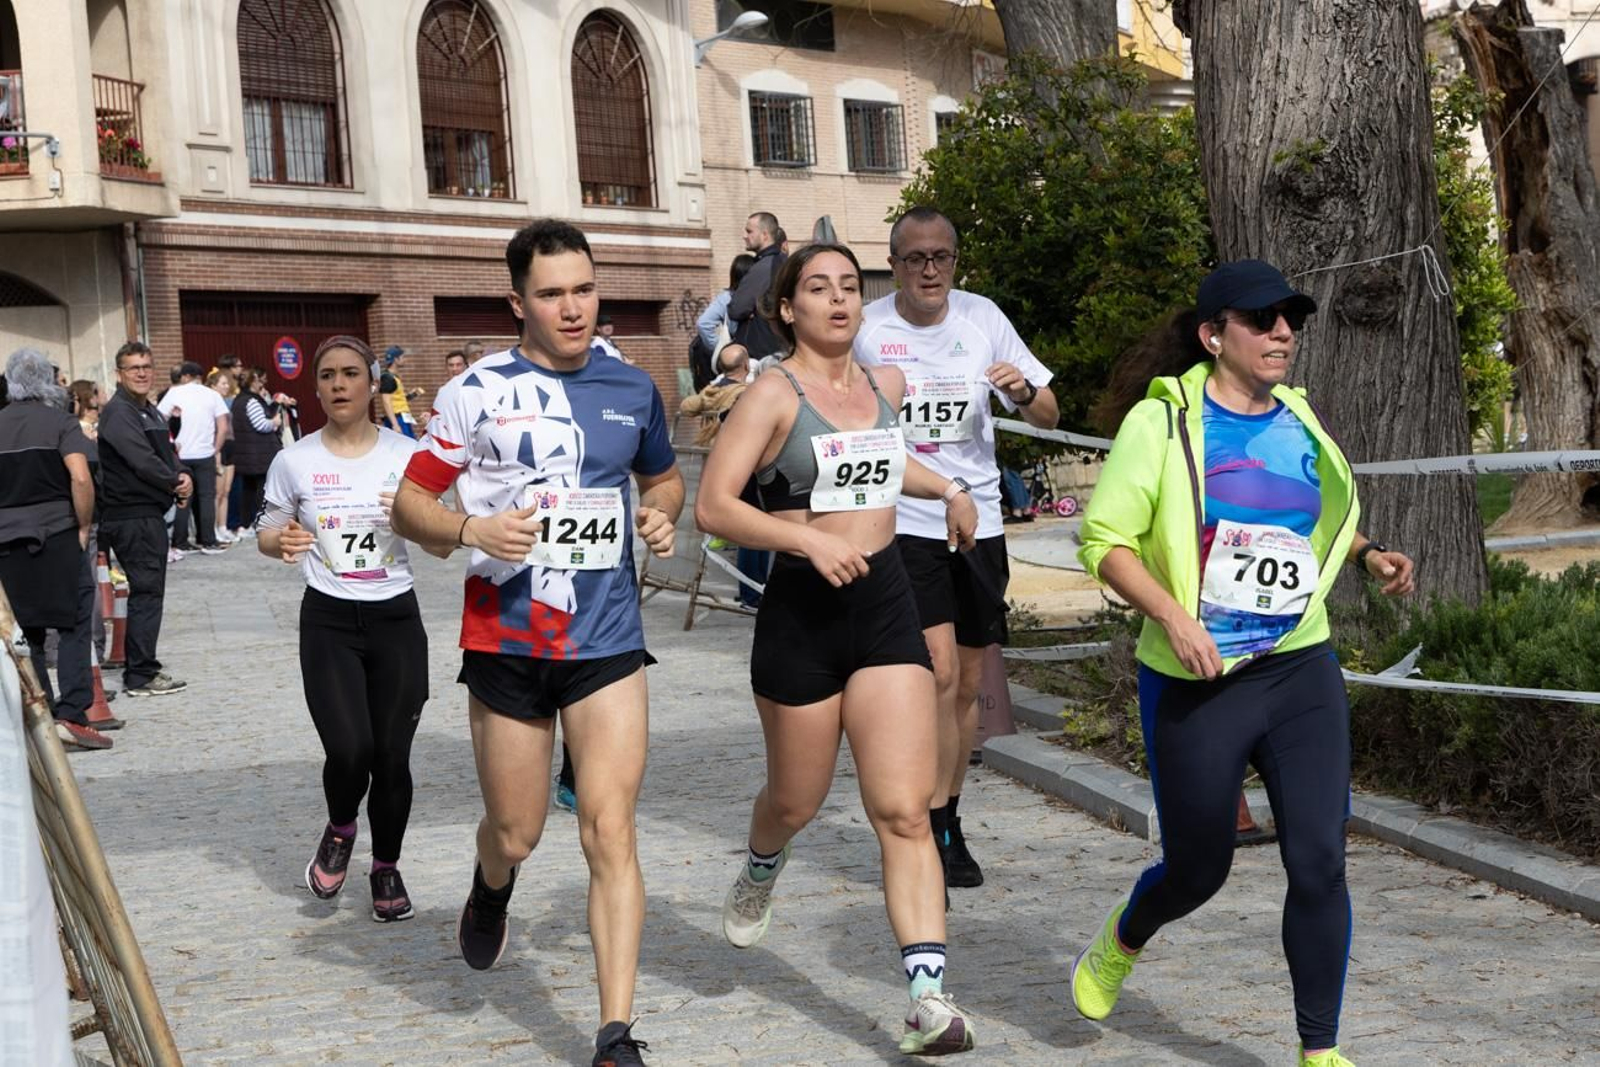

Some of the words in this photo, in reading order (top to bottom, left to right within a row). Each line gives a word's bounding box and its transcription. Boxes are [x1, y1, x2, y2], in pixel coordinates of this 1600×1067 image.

[880, 344, 907, 355] XXVII
[899, 401, 968, 422] 1157
[313, 474, 340, 484] XXVII
[834, 459, 890, 487] 925
[540, 516, 617, 544] 1244
[341, 532, 376, 553] 74
[1233, 553, 1300, 590] 703
